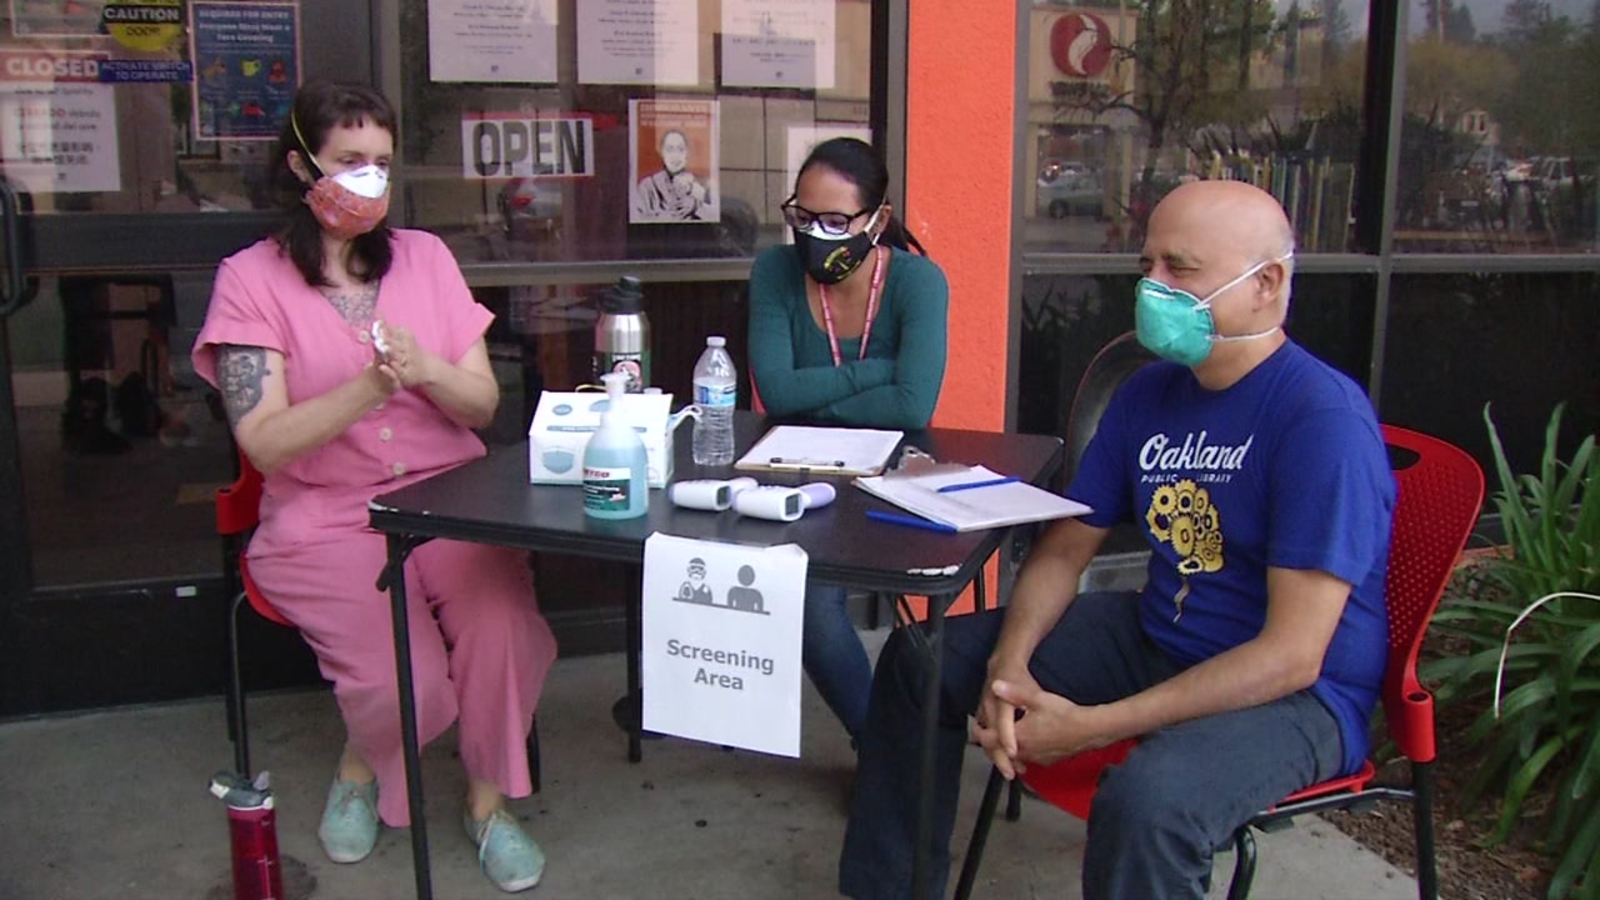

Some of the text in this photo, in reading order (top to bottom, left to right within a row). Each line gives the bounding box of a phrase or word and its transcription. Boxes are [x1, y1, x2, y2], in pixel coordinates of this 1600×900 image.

[104, 7, 180, 20] CAUTION
[6, 58, 99, 77] CLOSED
[102, 61, 190, 71] ACTIVATE SWITCH
[116, 71, 179, 80] TO OPERATE
[472, 121, 586, 176] OPEN
[1139, 430, 1254, 470] Oakland
[1141, 474, 1232, 483] PUBLIC LIBRARY
[667, 639, 774, 675] Screening
[694, 668, 744, 690] Area
